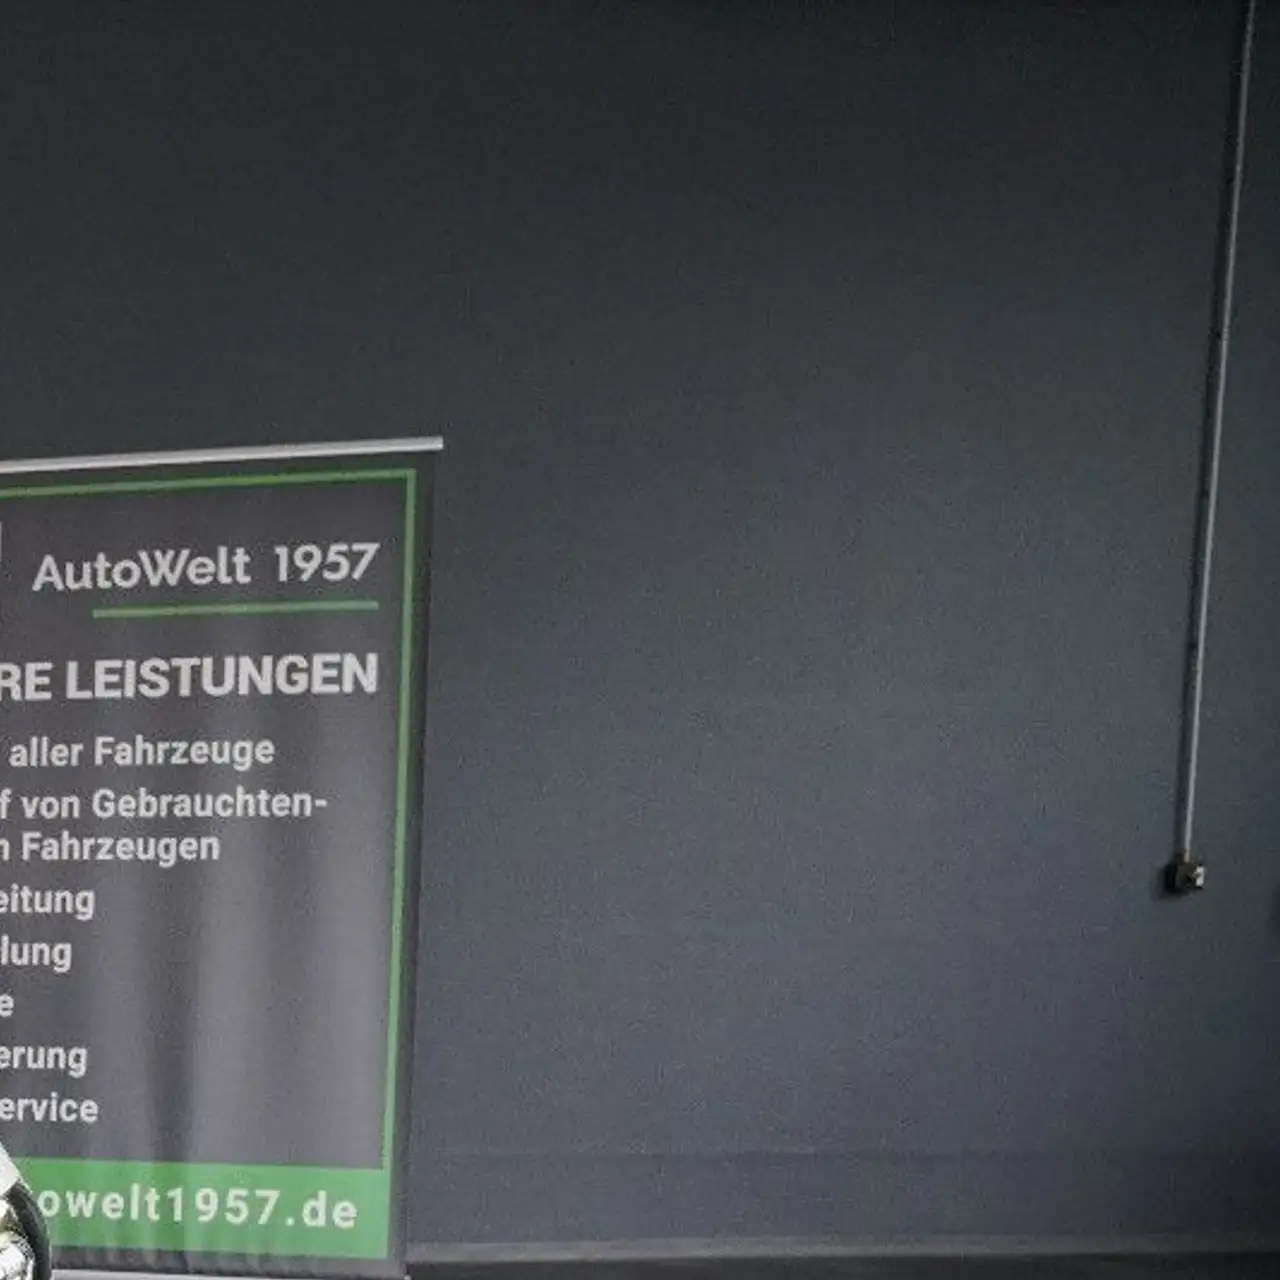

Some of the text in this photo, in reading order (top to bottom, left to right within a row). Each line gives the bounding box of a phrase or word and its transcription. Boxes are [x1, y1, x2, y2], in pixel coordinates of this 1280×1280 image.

[31, 542, 381, 592] AutoWelt 1957
[66, 653, 378, 699] LEISTUNGEN
[8, 736, 84, 767] aller
[94, 735, 276, 770] Fahrzeuge
[19, 798, 81, 819] von
[91, 789, 328, 818] Gebrauchten-
[22, 832, 221, 864] Fahrzeugen
[39, 1183, 358, 1229] owelt1957.de
